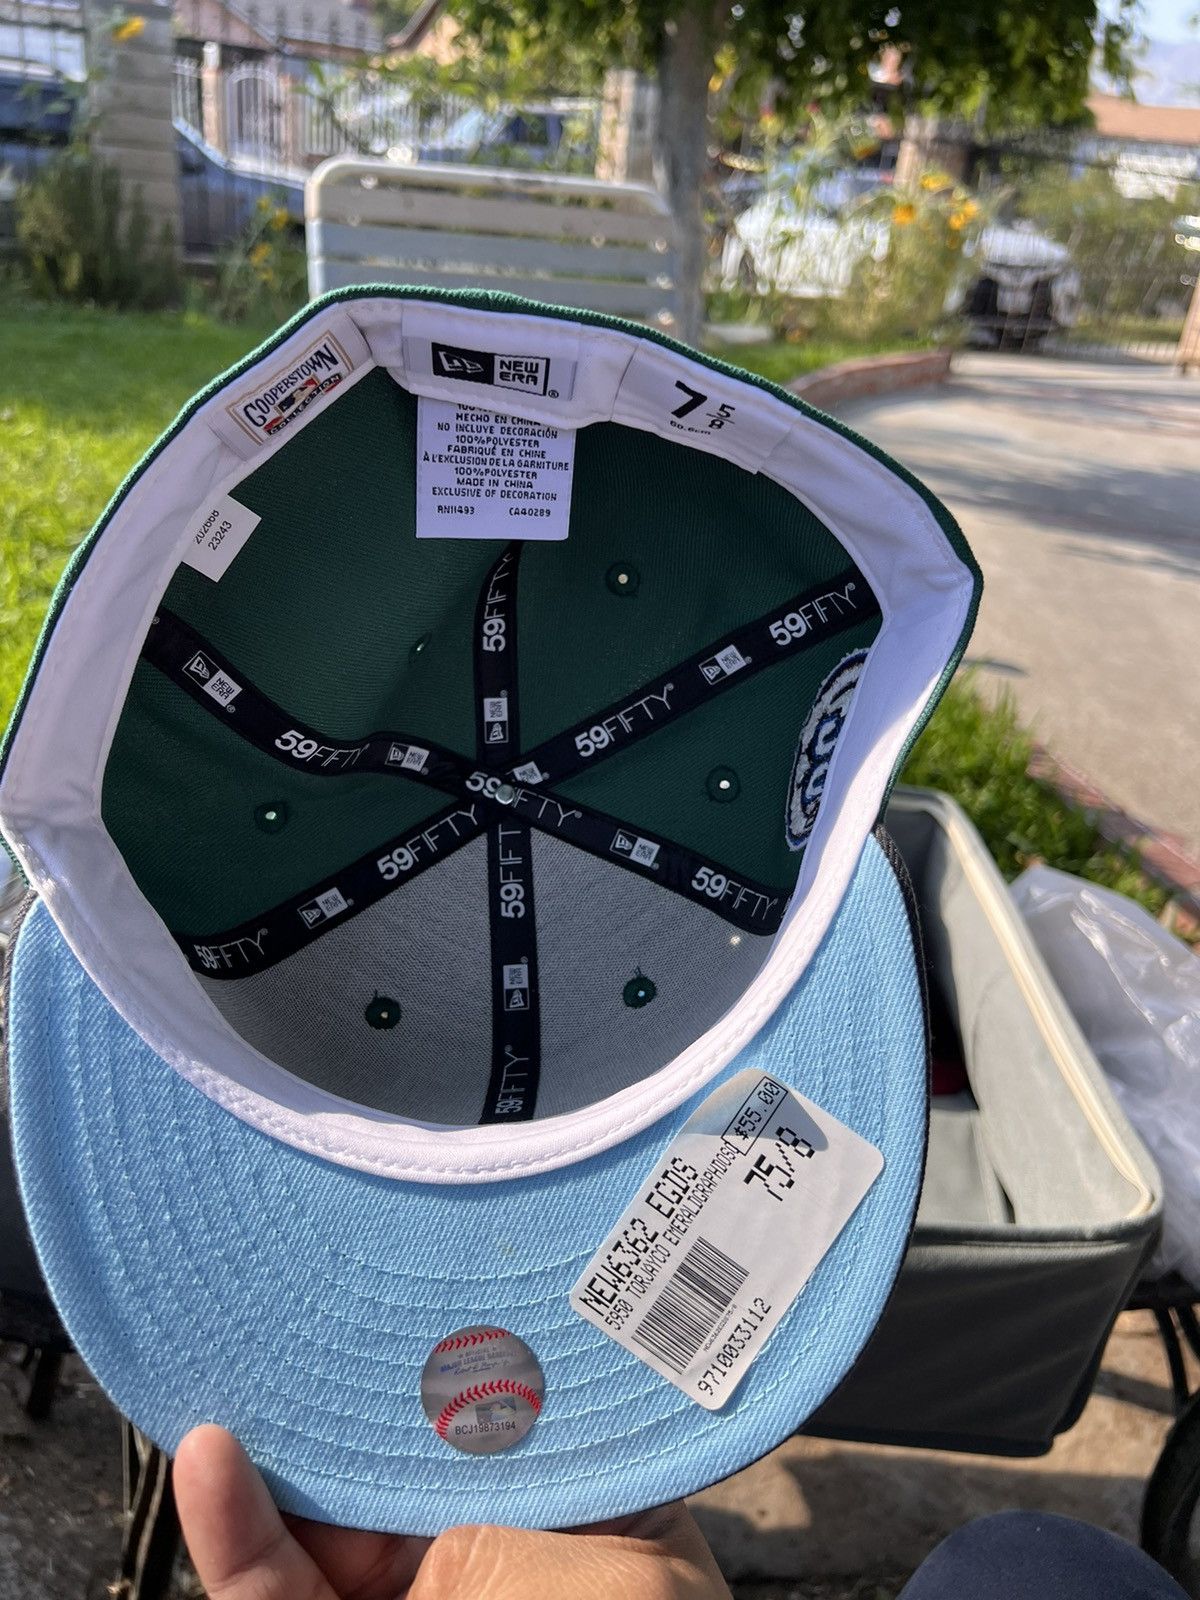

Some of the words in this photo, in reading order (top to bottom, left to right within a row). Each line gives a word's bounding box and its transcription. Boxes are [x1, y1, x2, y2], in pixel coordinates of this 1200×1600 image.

[499, 371, 538, 386] ERA
[500, 360, 539, 374] NEW
[243, 344, 338, 428] COOPERSTOWN
[671, 381, 708, 418] 7
[437, 422, 450, 431] NO
[455, 423, 495, 434] INCLUYE
[500, 427, 558, 439] DECORACIÓN
[456, 413, 490, 424] HECHO
[495, 415, 508, 424] EN
[447, 444, 496, 456] FABRIQUÉ
[501, 448, 514, 457] EN
[519, 449, 546, 459] CHINE
[456, 435, 540, 448] 100%POLYESTER
[423, 450, 430, 461] À
[489, 458, 500, 466] DE
[502, 459, 515, 468] LA
[517, 460, 569, 471] GARNITURE
[454, 467, 538, 480] 100%POLYESTER
[432, 487, 481, 498] EXCLUSIVE
[485, 489, 496, 497] OF
[500, 490, 557, 501] DECORATION
[456, 477, 485, 487] MADE
[489, 478, 500, 487] IN
[504, 480, 533, 489] CHINA
[437, 505, 475, 515] RN11493
[509, 507, 551, 517] CA40289
[208, 521, 232, 551] 23243
[768, 585, 857, 646] 59FIFTY
[210, 682, 229, 699] ERA
[215, 677, 235, 694] NEW
[574, 685, 671, 757] 59FIFTY
[275, 729, 370, 768] 59FIFTY
[465, 771, 577, 827] 59IFTY
[376, 804, 478, 880] 59FIFTY
[499, 824, 525, 918] 59FIFT
[691, 866, 775, 920] 59FIFTY
[734, 1082, 780, 1140] $55.00
[743, 1126, 815, 1201] 75/8
[579, 1218, 659, 1316] NEW6362
[645, 1157, 698, 1218] EGDS
[605, 1299, 633, 1330] 5950
[625, 1244, 671, 1299] TORJAYCO
[698, 1298, 771, 1395] 9710033112
[455, 1421, 516, 1435] BCJ19873194
